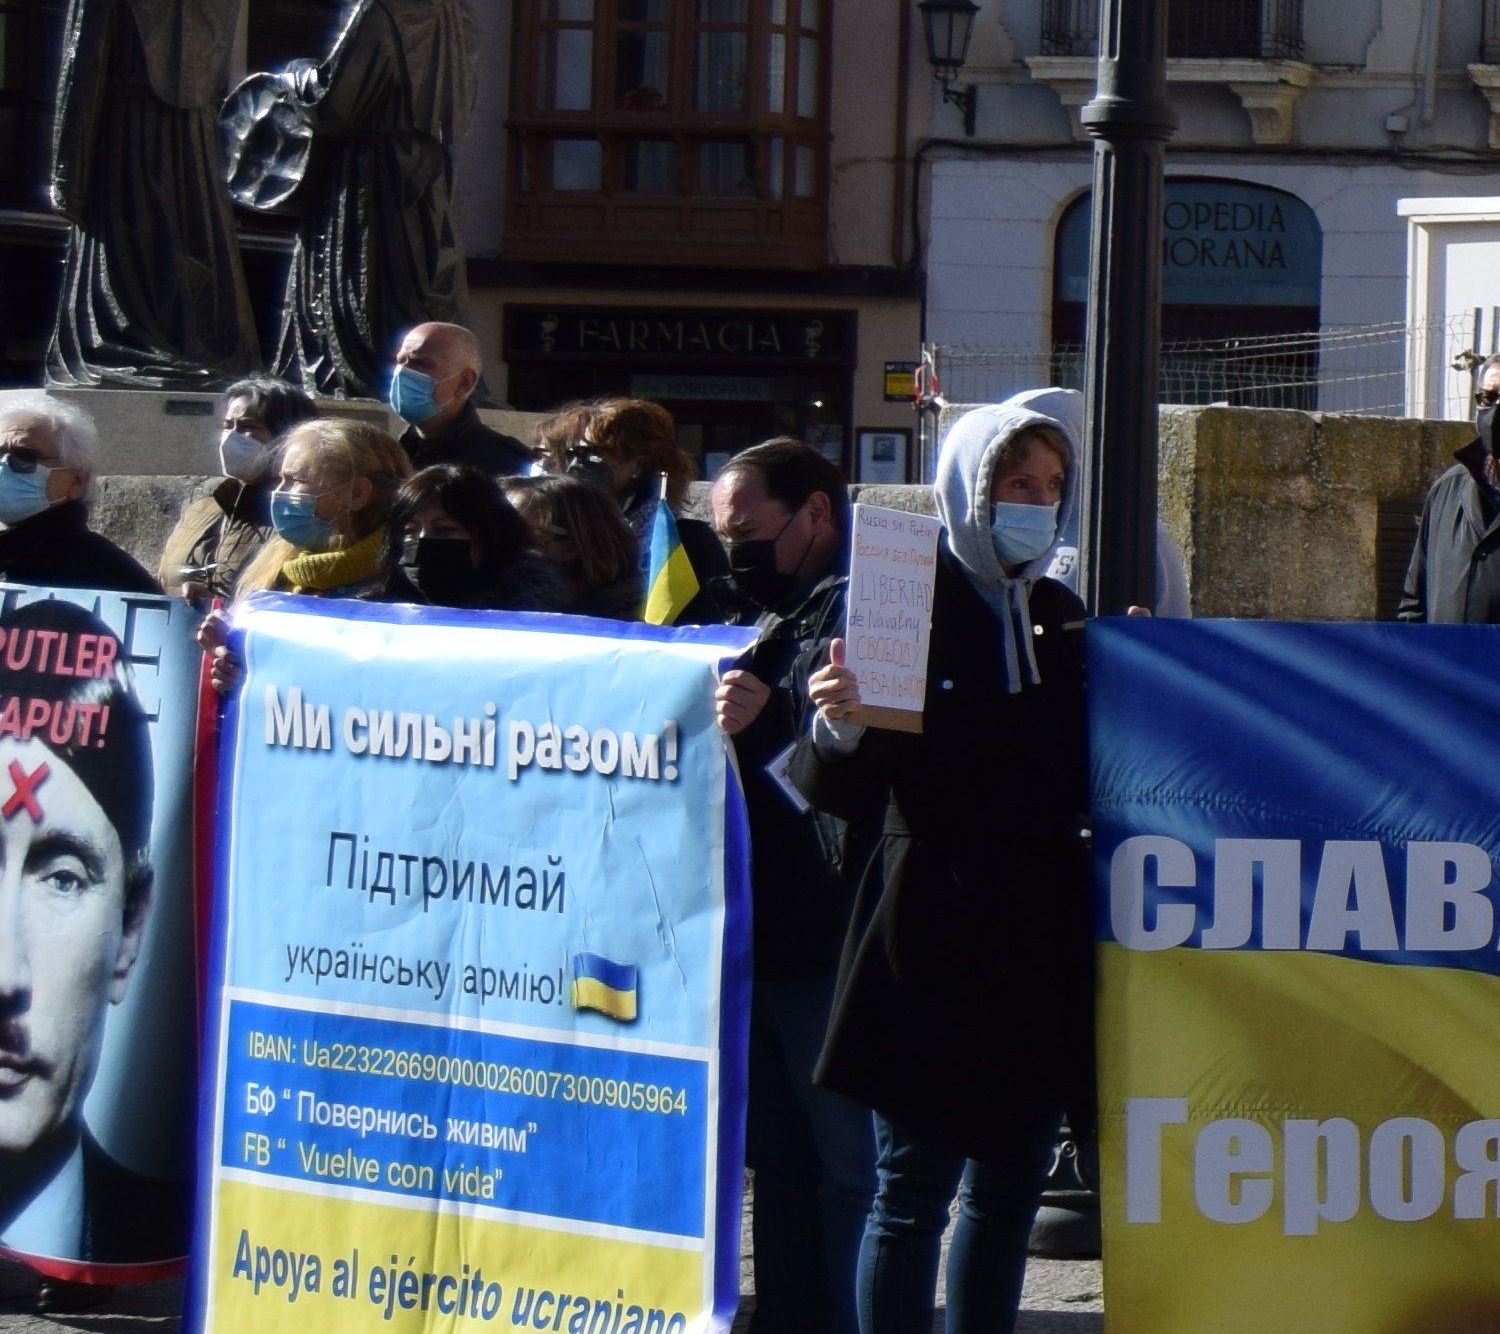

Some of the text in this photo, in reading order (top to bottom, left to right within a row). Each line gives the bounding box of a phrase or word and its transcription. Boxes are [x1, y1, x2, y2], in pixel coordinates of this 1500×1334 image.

[578, 319, 782, 353] FARMACIA
[858, 507, 888, 530] Rusia
[892, 519, 905, 532] sin
[860, 572, 933, 613] LIBERTAD
[0, 625, 119, 679] UTLER
[848, 607, 921, 643] de Navalny
[0, 695, 110, 749] APUT!
[264, 684, 681, 782] Ми сильні разом!
[326, 831, 568, 914] Підтримай
[284, 943, 564, 1007] українську армію!
[248, 1030, 689, 1116] IBAN: Ua223226690000026007300905964
[246, 1082, 276, 1118] БФ
[297, 1090, 439, 1141] Повернись
[244, 1131, 272, 1169] FB
[299, 1140, 381, 1184] Vuelve
[386, 1158, 434, 1191] con
[232, 1229, 323, 1303] Apoya
[332, 1248, 359, 1300] al
[368, 1254, 502, 1321] ejército
